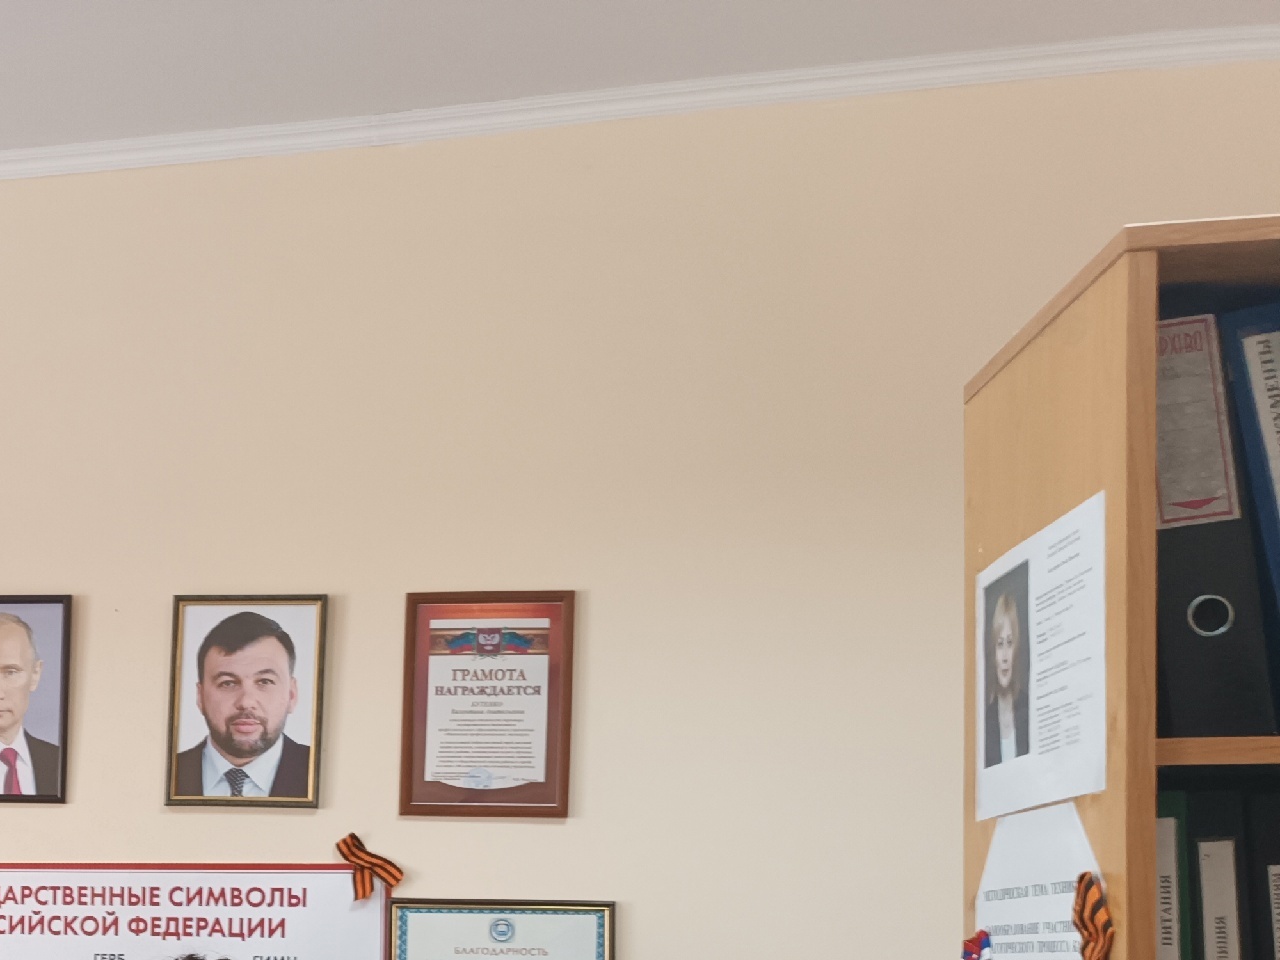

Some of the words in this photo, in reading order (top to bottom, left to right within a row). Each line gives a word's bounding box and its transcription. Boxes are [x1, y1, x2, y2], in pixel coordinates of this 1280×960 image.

[451, 668, 528, 681] ГРАМОТА
[434, 685, 542, 696] НАГРАЖДАЕТСЯ
[168, 885, 308, 908] СИМВОЛЫ
[1158, 875, 1174, 946] ПИТАНИЯ
[126, 915, 287, 942] ФЕДЕРАЦИИ
[454, 947, 549, 957] БЛАГОДАРНОСТЬ
